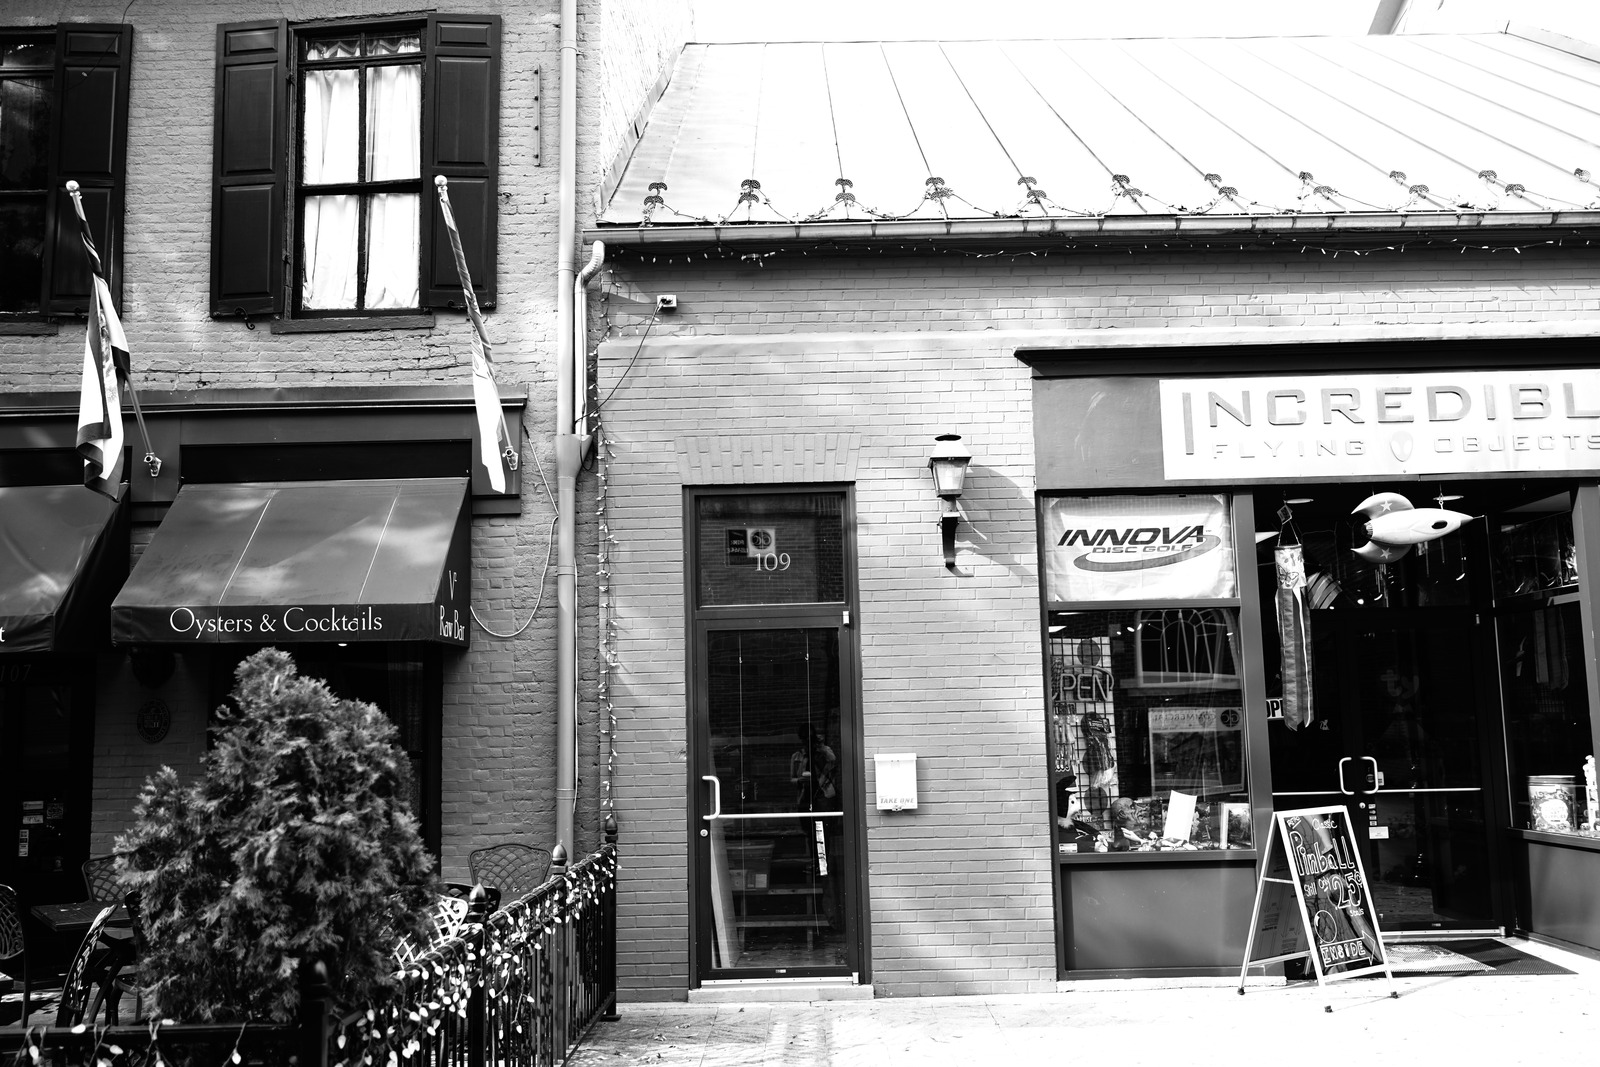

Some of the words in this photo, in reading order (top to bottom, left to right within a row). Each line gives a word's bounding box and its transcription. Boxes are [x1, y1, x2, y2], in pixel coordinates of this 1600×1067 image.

[1212, 439, 1366, 459] FLYING
[1434, 434, 1600, 454] OBJECTS
[1057, 525, 1204, 546] INNOVA
[1092, 546, 1137, 554] DISC
[1142, 543, 1193, 553] GOLF
[754, 552, 791, 572] 109
[169, 606, 253, 639] Oysters
[259, 613, 277, 632] &
[283, 606, 383, 632] Cocktails
[439, 604, 454, 638] Raw
[453, 609, 466, 641] Bar
[1052, 673, 1110, 702] PEN
[1320, 941, 1366, 964] INSIDE
